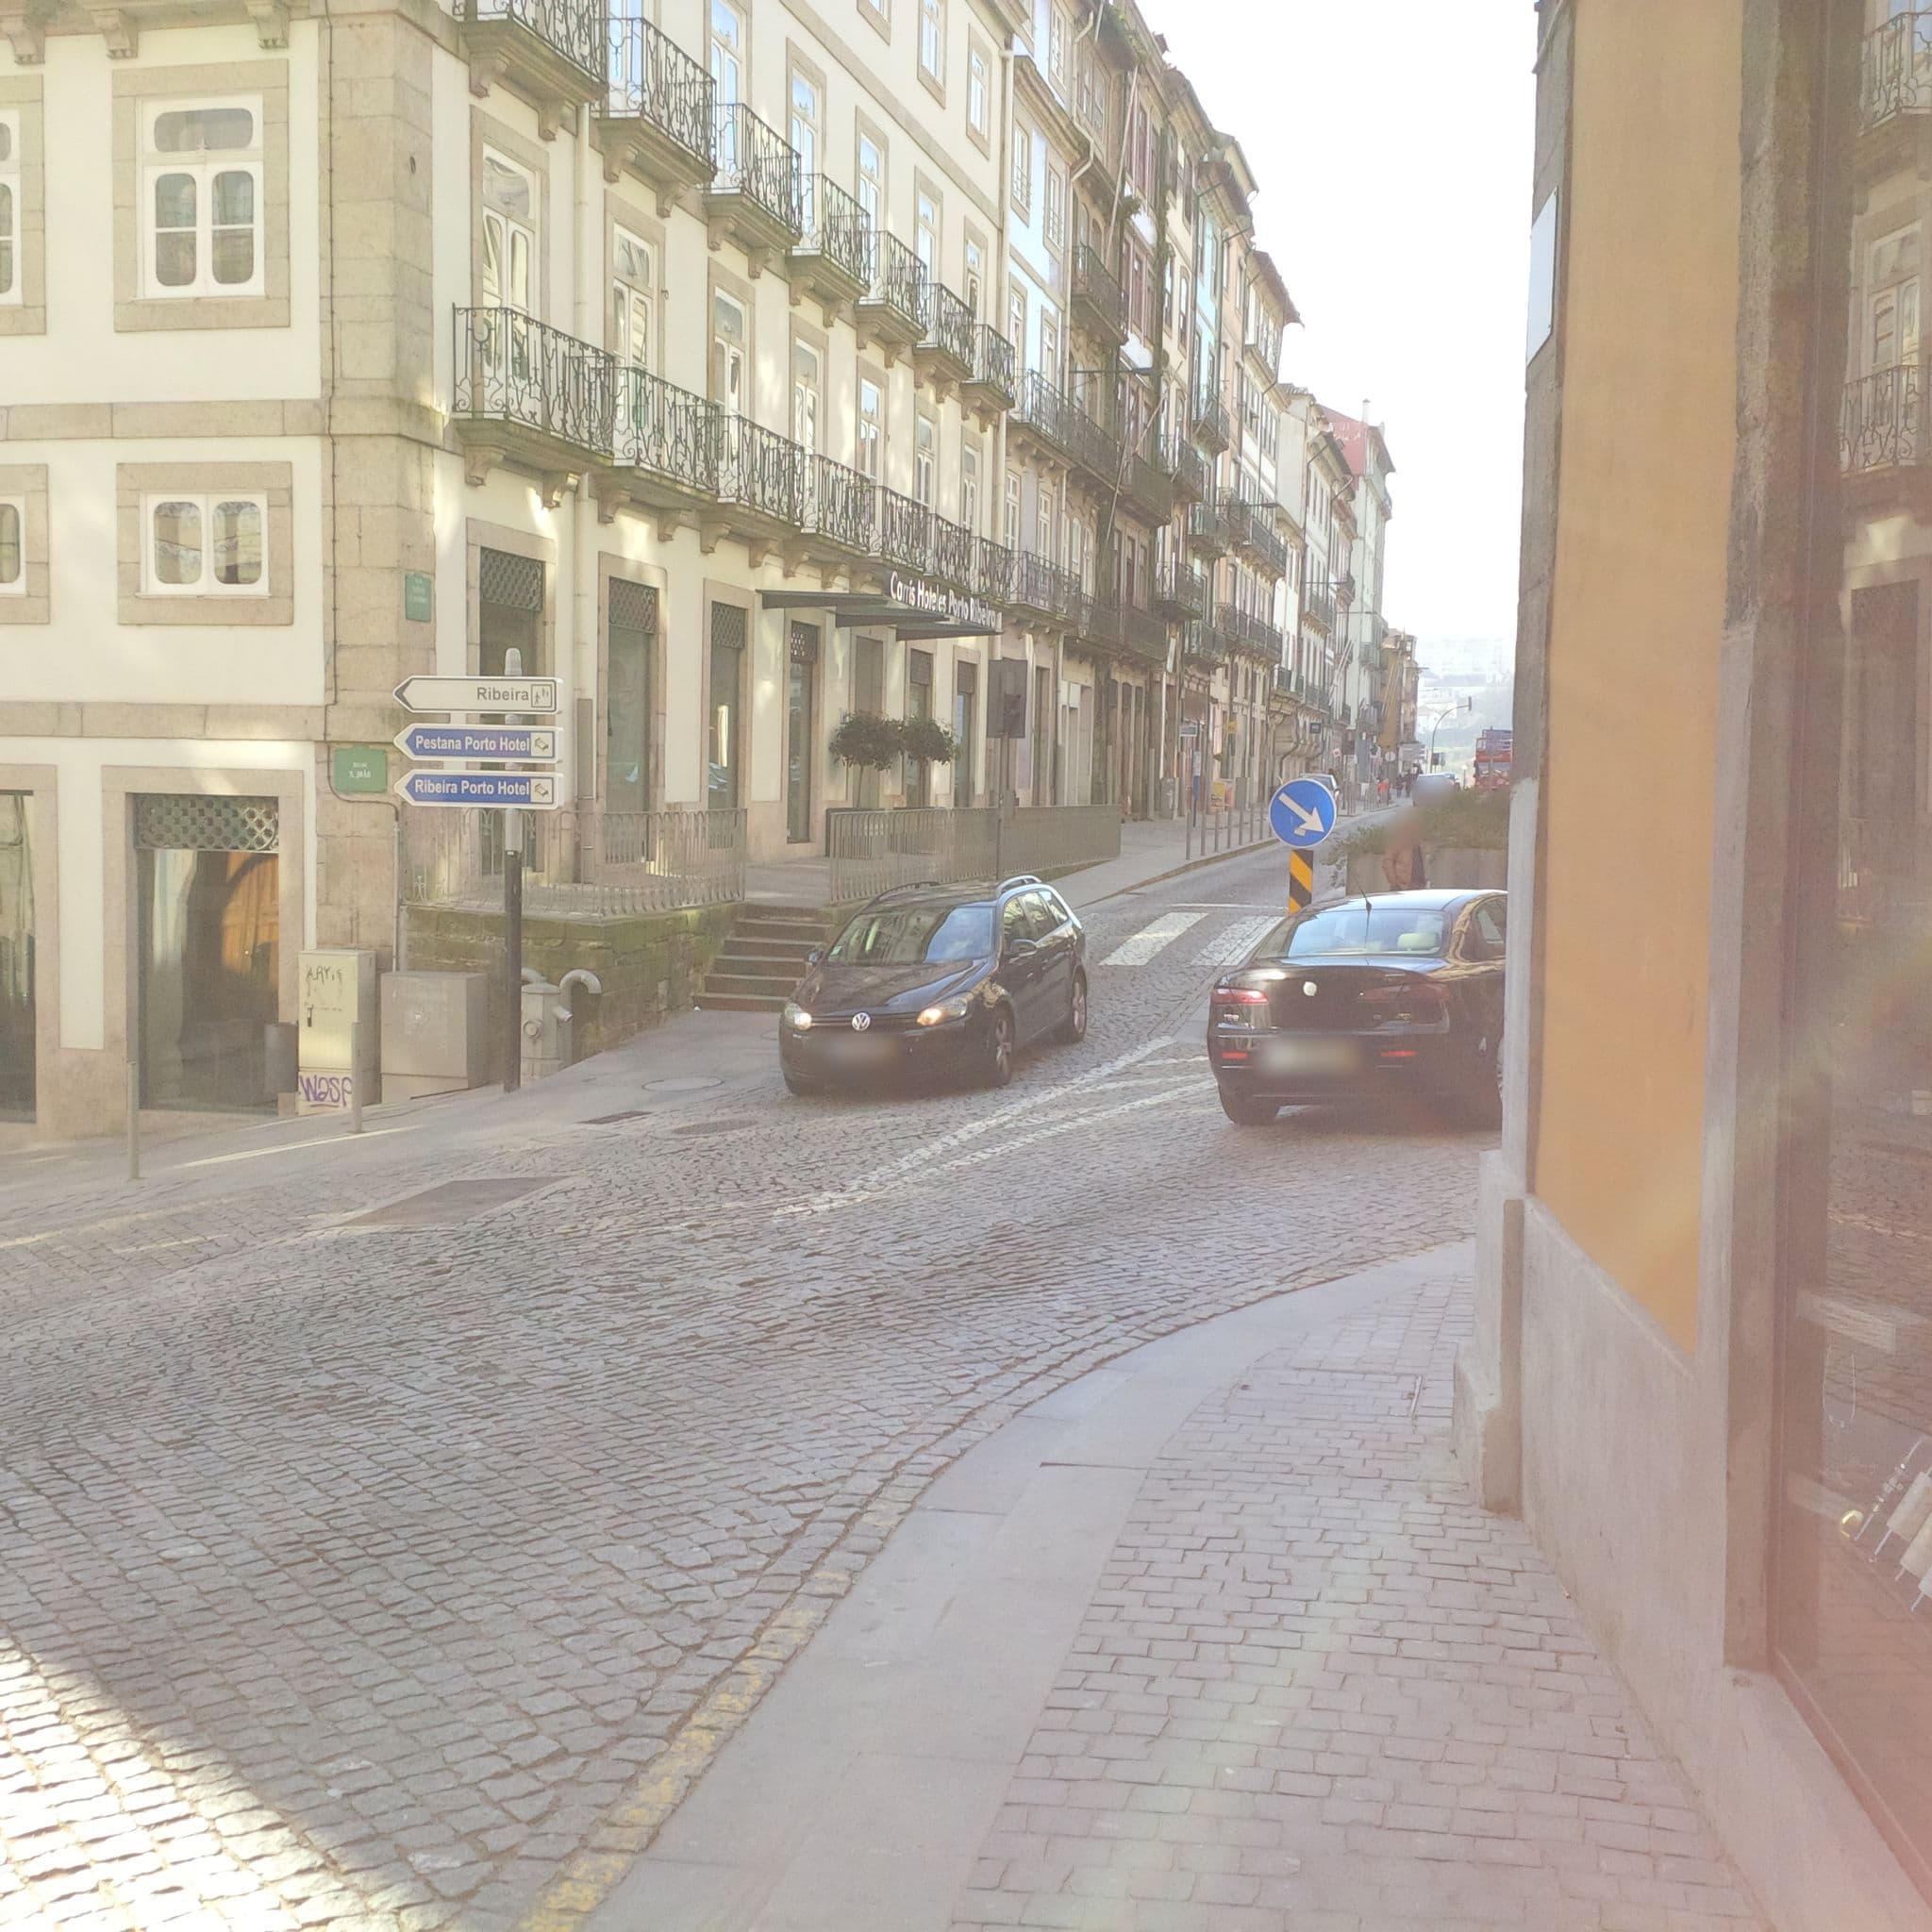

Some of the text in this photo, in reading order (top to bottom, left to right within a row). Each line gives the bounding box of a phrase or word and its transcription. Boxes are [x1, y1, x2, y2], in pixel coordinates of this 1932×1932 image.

[917, 579, 947, 613] Hoteles
[948, 589, 969, 621] Porto
[476, 687, 529, 702] Ribeira
[415, 735, 530, 752] Pestana Porto Hotel
[415, 779, 530, 796] Ribeira Porto Hotel
